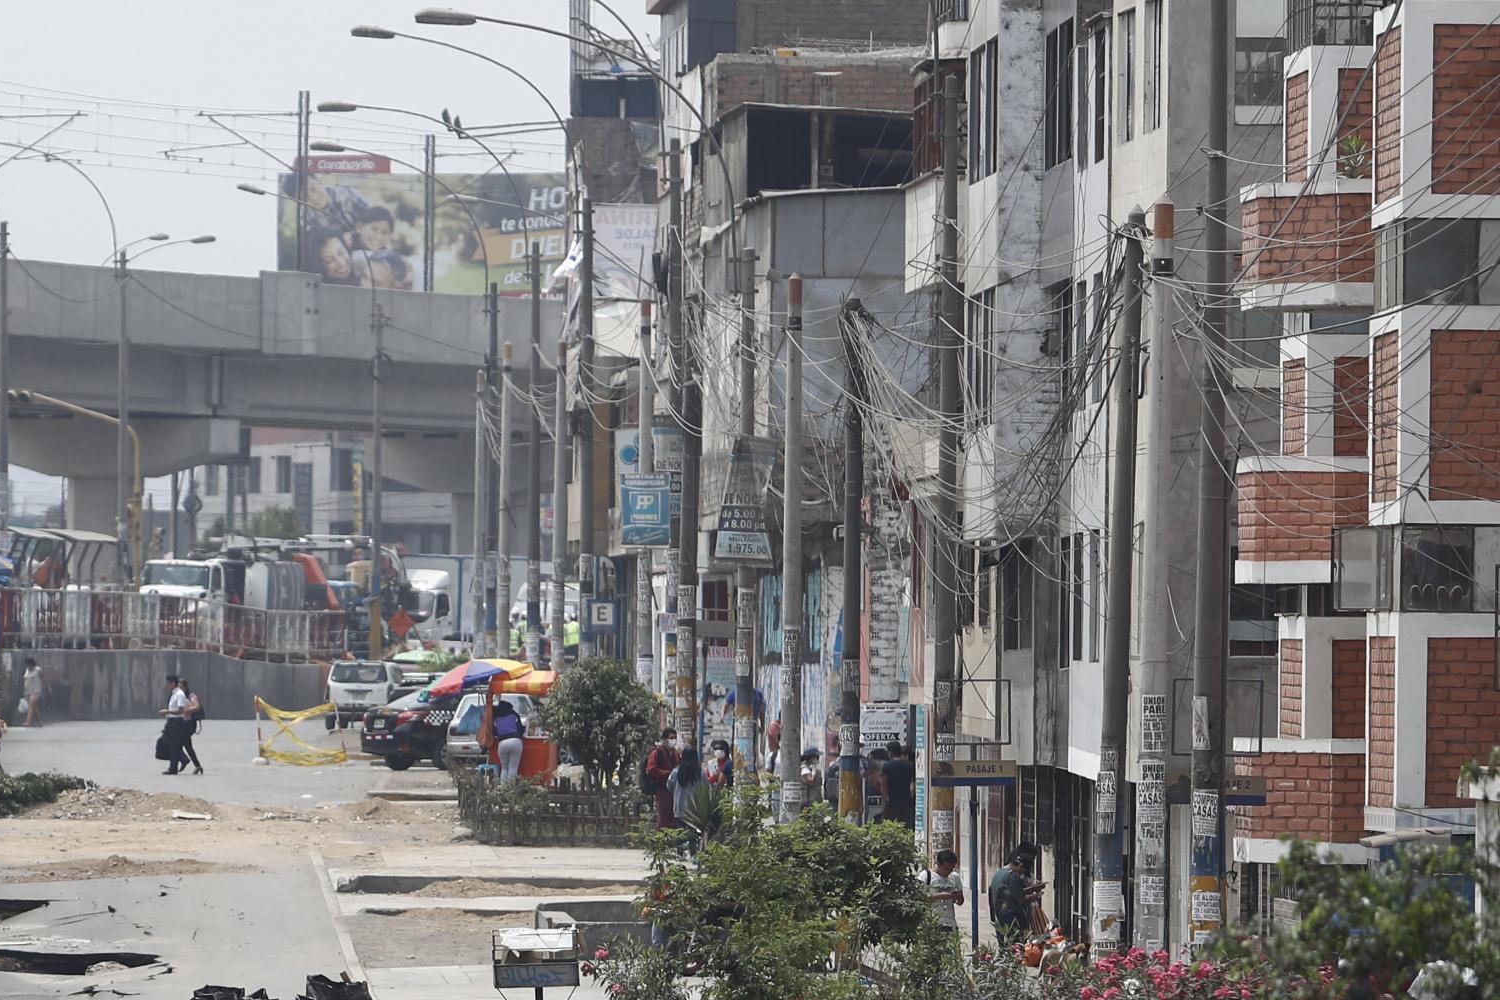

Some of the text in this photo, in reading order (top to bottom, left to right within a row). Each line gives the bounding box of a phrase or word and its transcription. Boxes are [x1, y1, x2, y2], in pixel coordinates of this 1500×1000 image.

[529, 186, 567, 211] HO
[501, 217, 516, 232] te
[1143, 705, 1167, 714] PARE
[966, 765, 996, 773] PASAJE
[1244, 781, 1251, 789] 2
[1138, 793, 1162, 806] CASAS
[1194, 793, 1218, 806] COMPRO
[1193, 804, 1217, 819] CASAS
